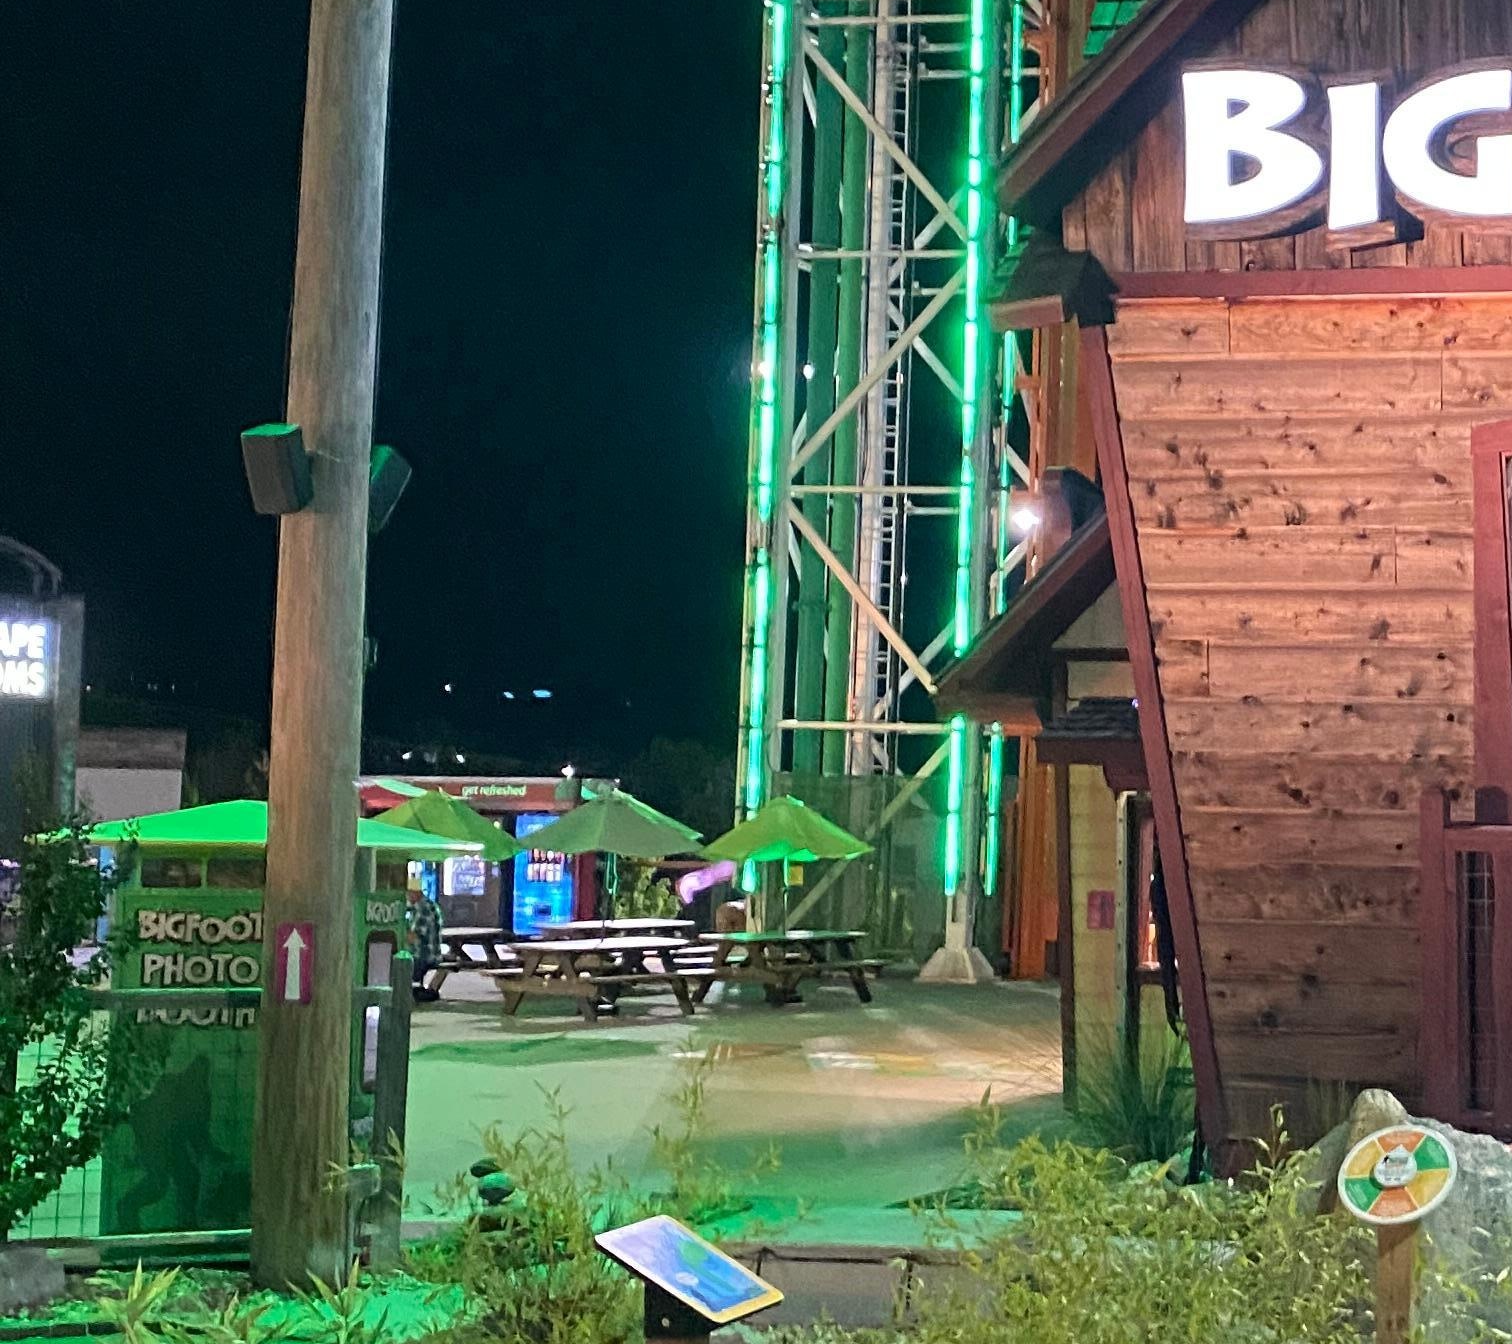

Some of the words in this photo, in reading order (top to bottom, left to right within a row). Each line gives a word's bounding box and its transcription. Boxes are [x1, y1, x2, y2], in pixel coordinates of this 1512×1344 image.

[462, 785, 479, 798] get
[480, 784, 527, 796] refreshed
[143, 953, 259, 986] PHOTO
